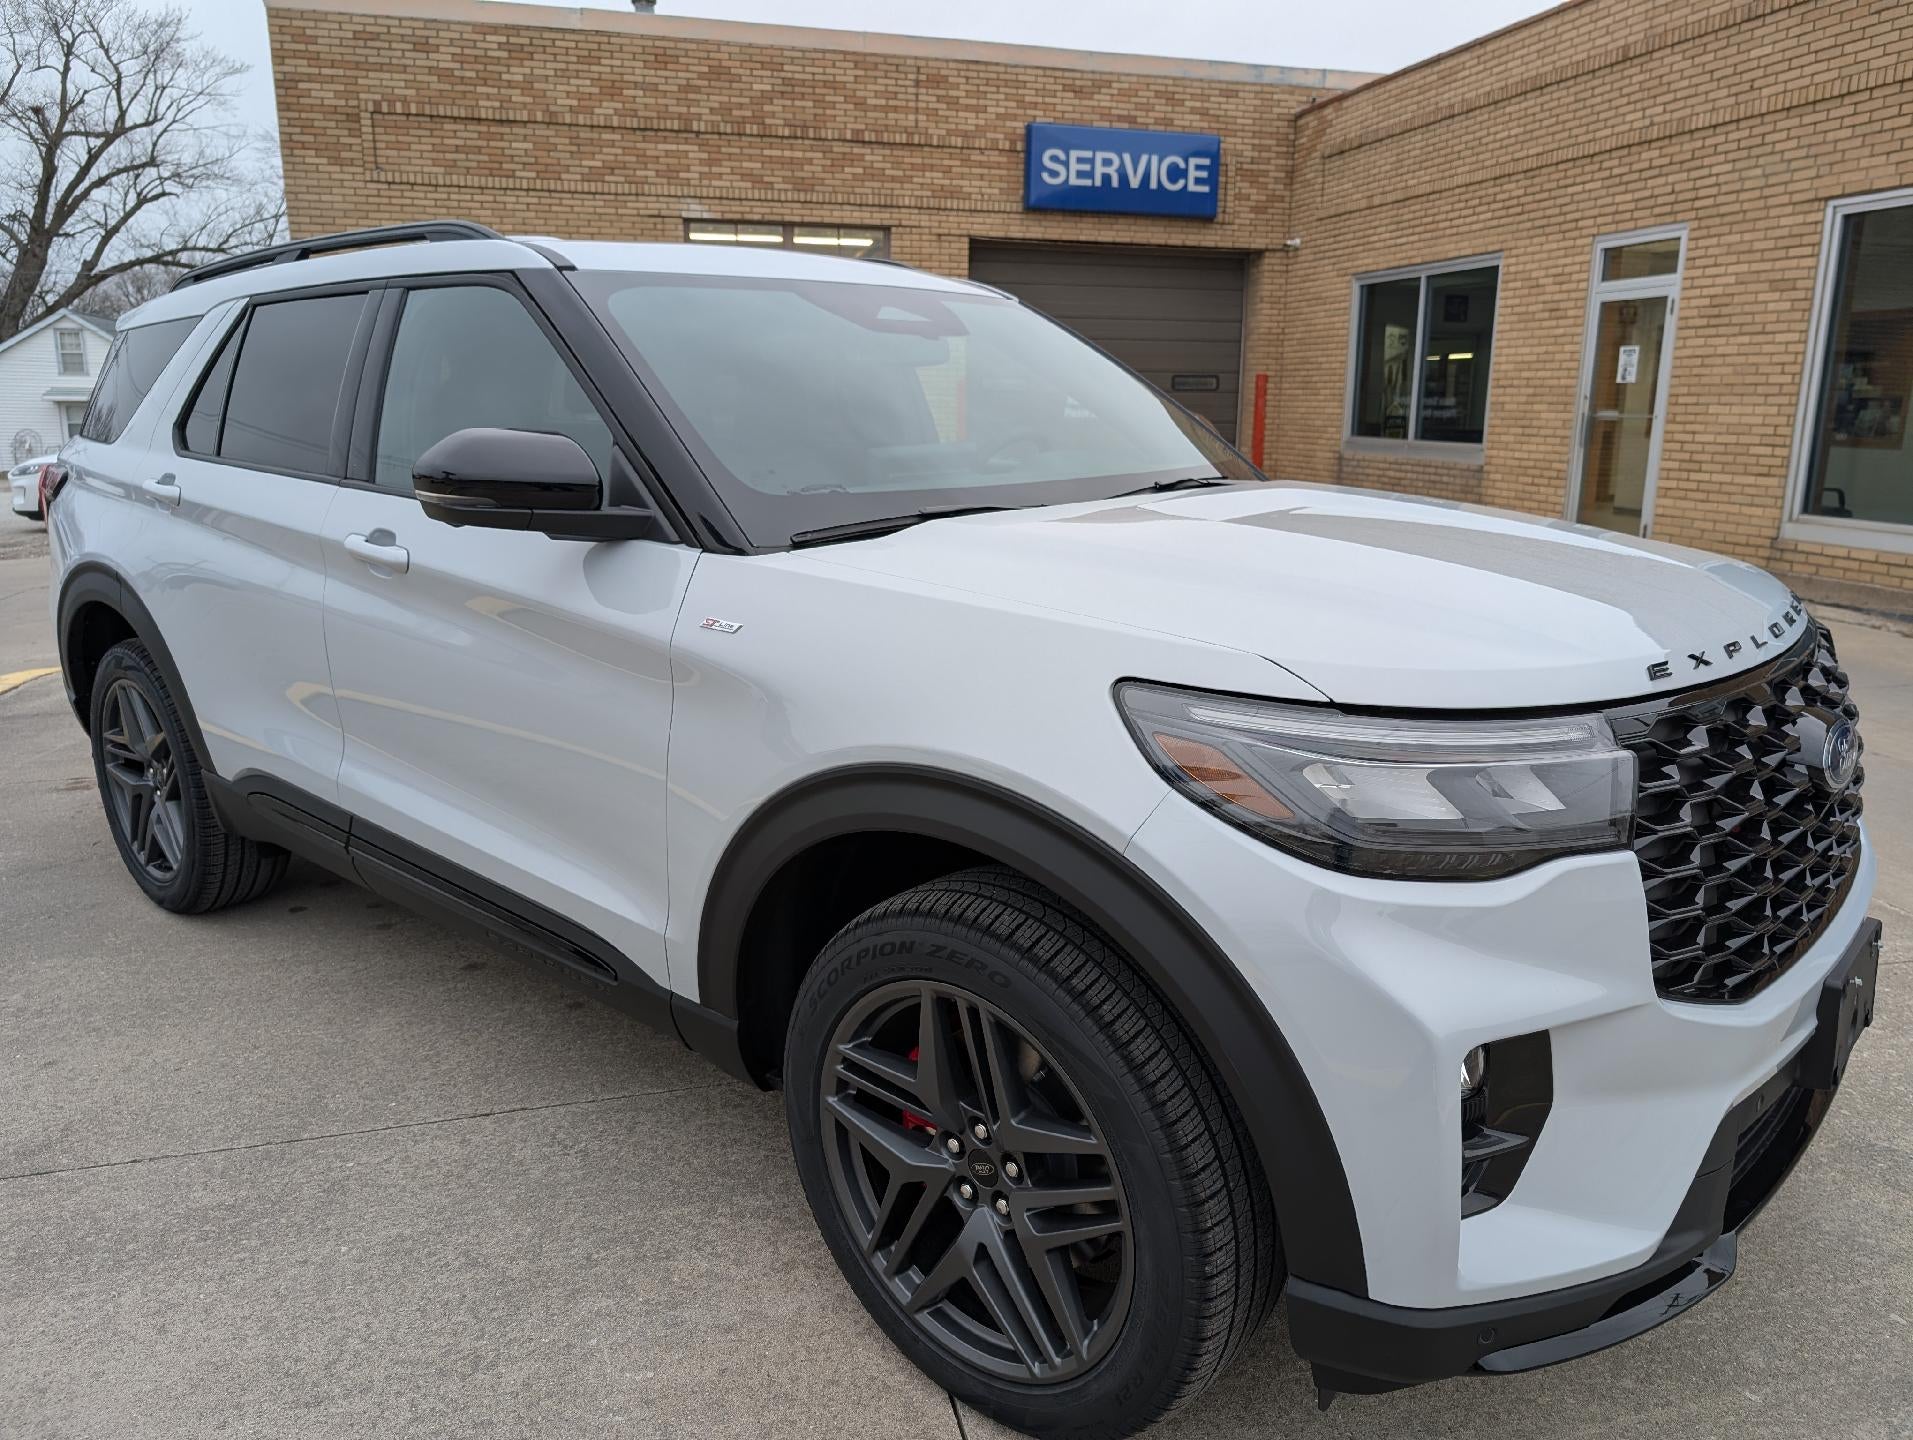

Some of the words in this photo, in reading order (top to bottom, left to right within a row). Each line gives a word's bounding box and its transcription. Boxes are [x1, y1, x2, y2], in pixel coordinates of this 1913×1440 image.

[1040, 148, 1211, 193] SERVICE
[808, 939, 916, 1013] SCORPION
[925, 942, 1013, 990] ZERO
